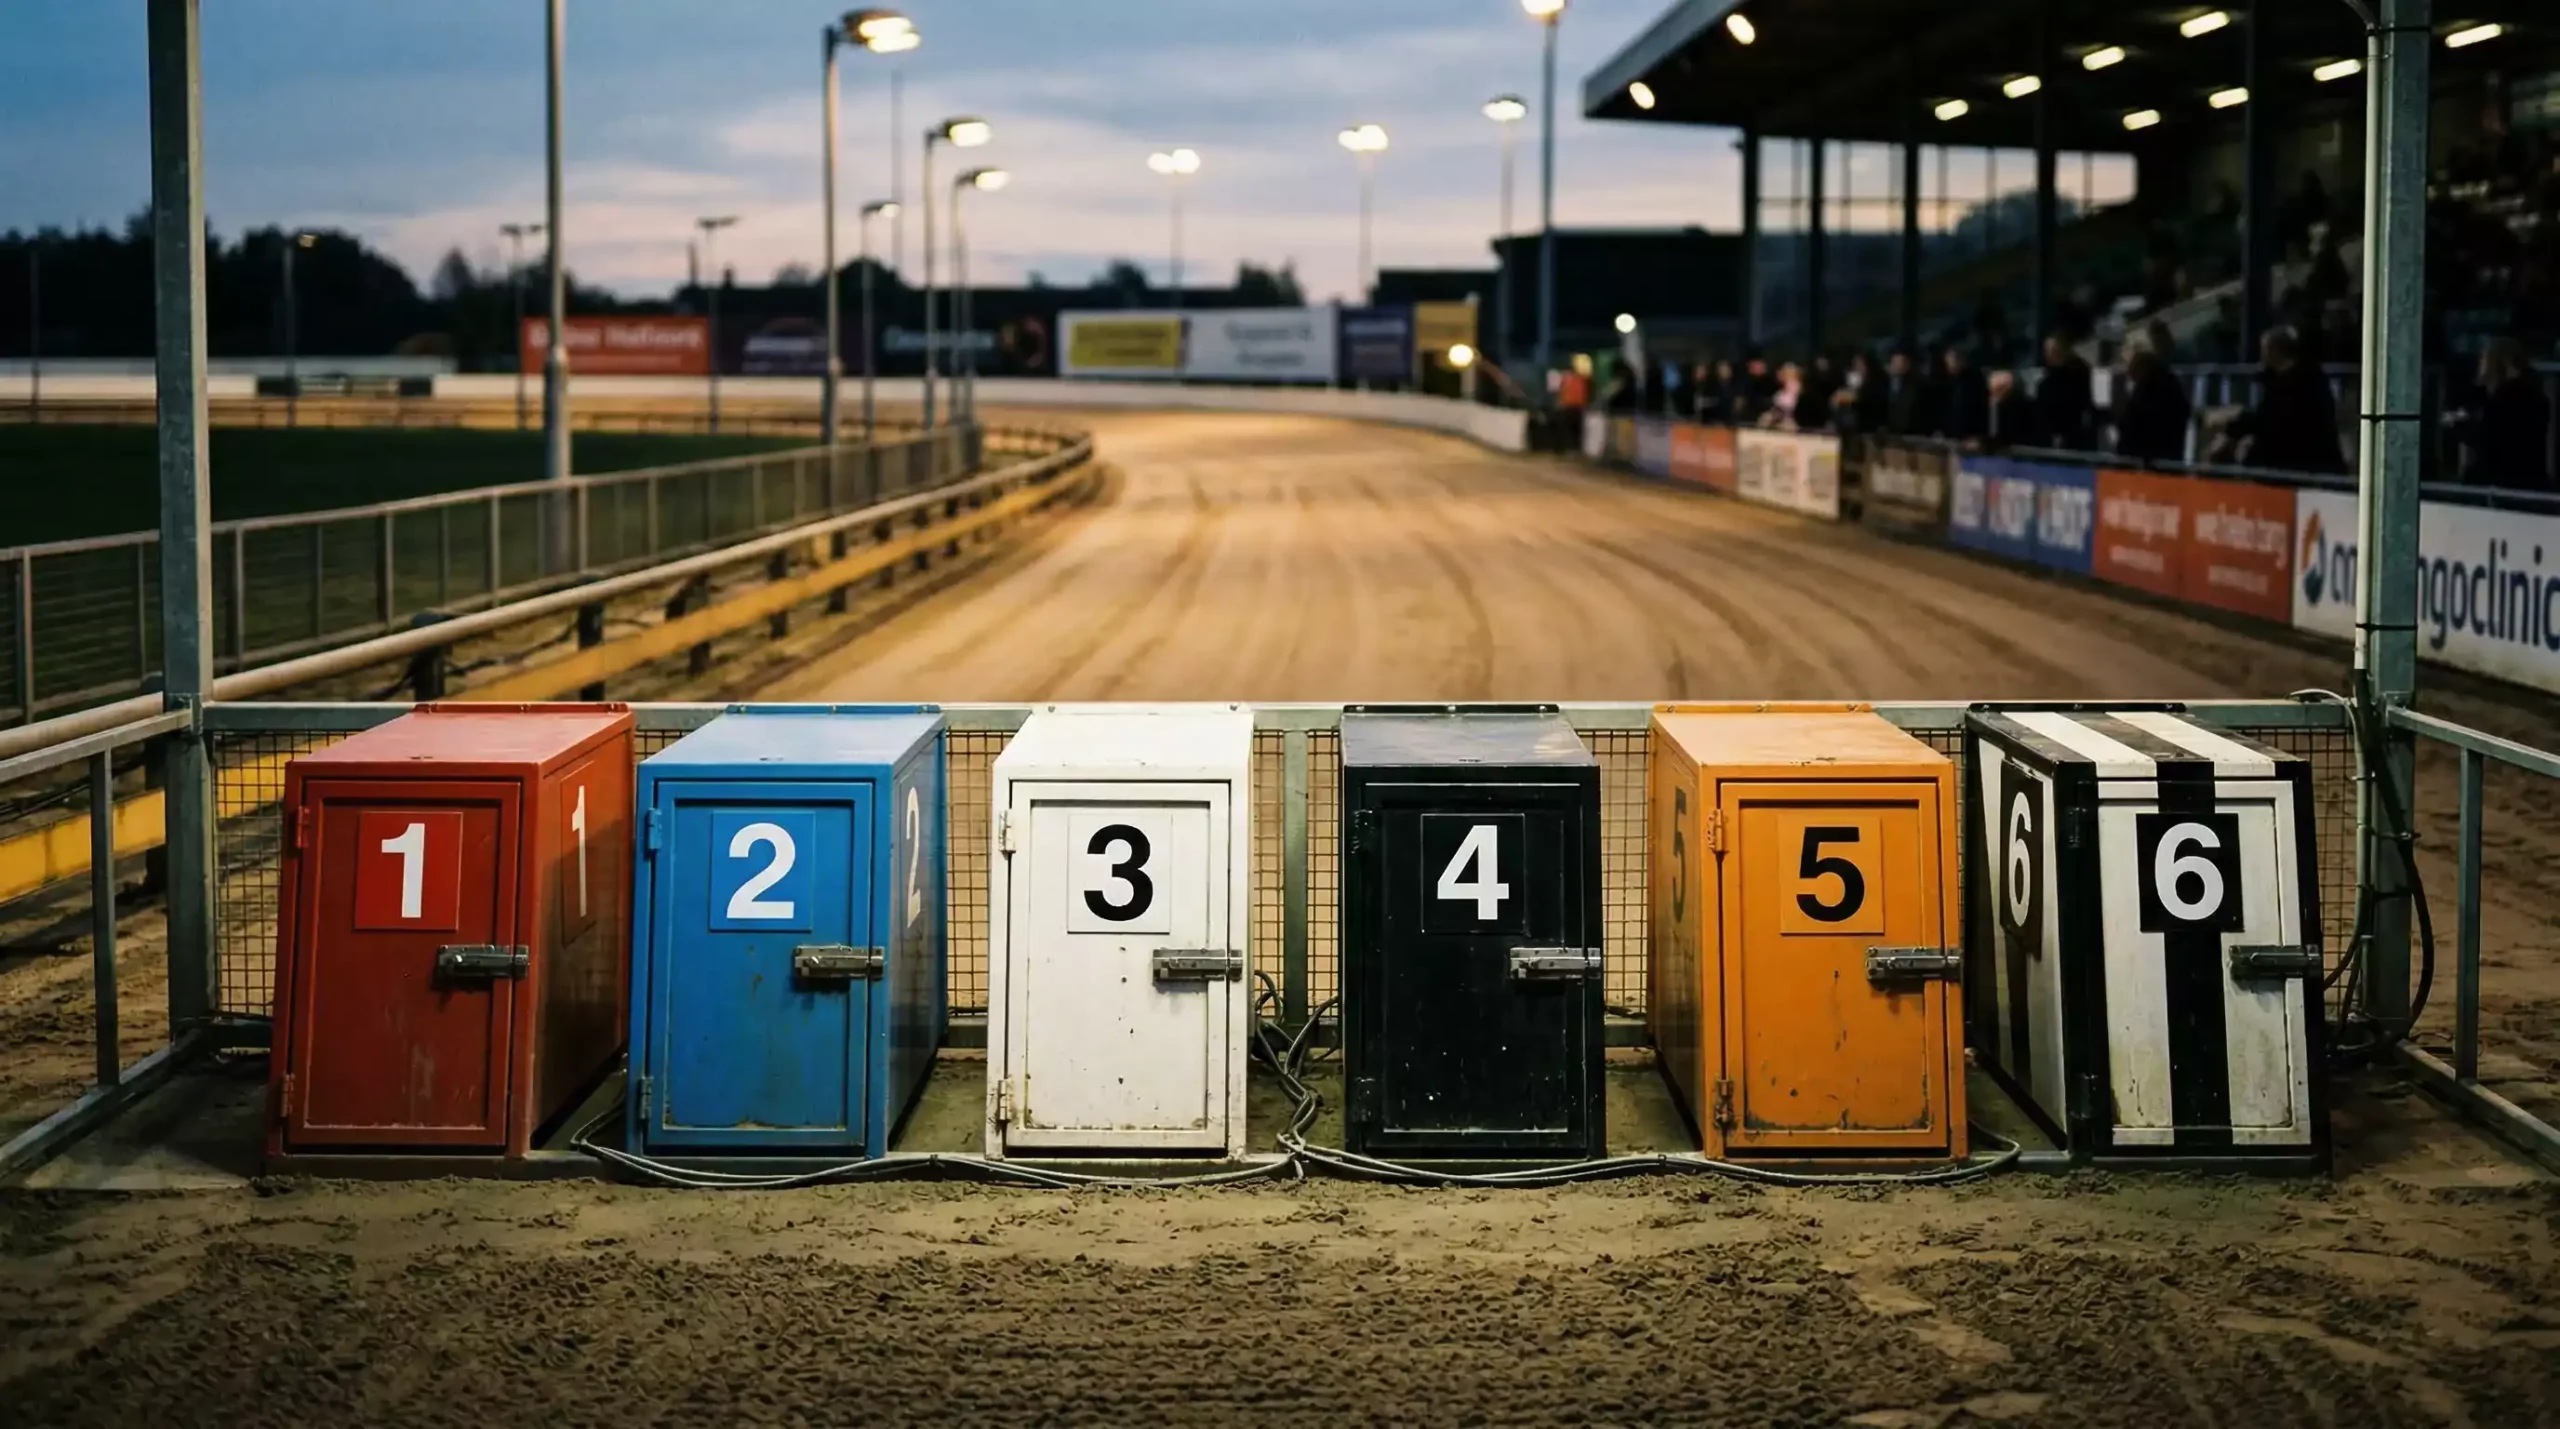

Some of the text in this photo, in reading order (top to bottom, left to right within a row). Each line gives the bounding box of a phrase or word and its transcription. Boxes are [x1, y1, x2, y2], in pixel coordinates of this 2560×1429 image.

[381, 823, 425, 918] 1
[571, 785, 587, 917] 1
[726, 822, 796, 919] 2
[906, 786, 921, 929] 2
[1083, 824, 1154, 921] 3
[1436, 825, 1509, 920] 4
[1672, 787, 1687, 924] 5
[1796, 826, 1865, 922] 5
[2007, 791, 2032, 927] 6
[2154, 822, 2224, 920] 6
